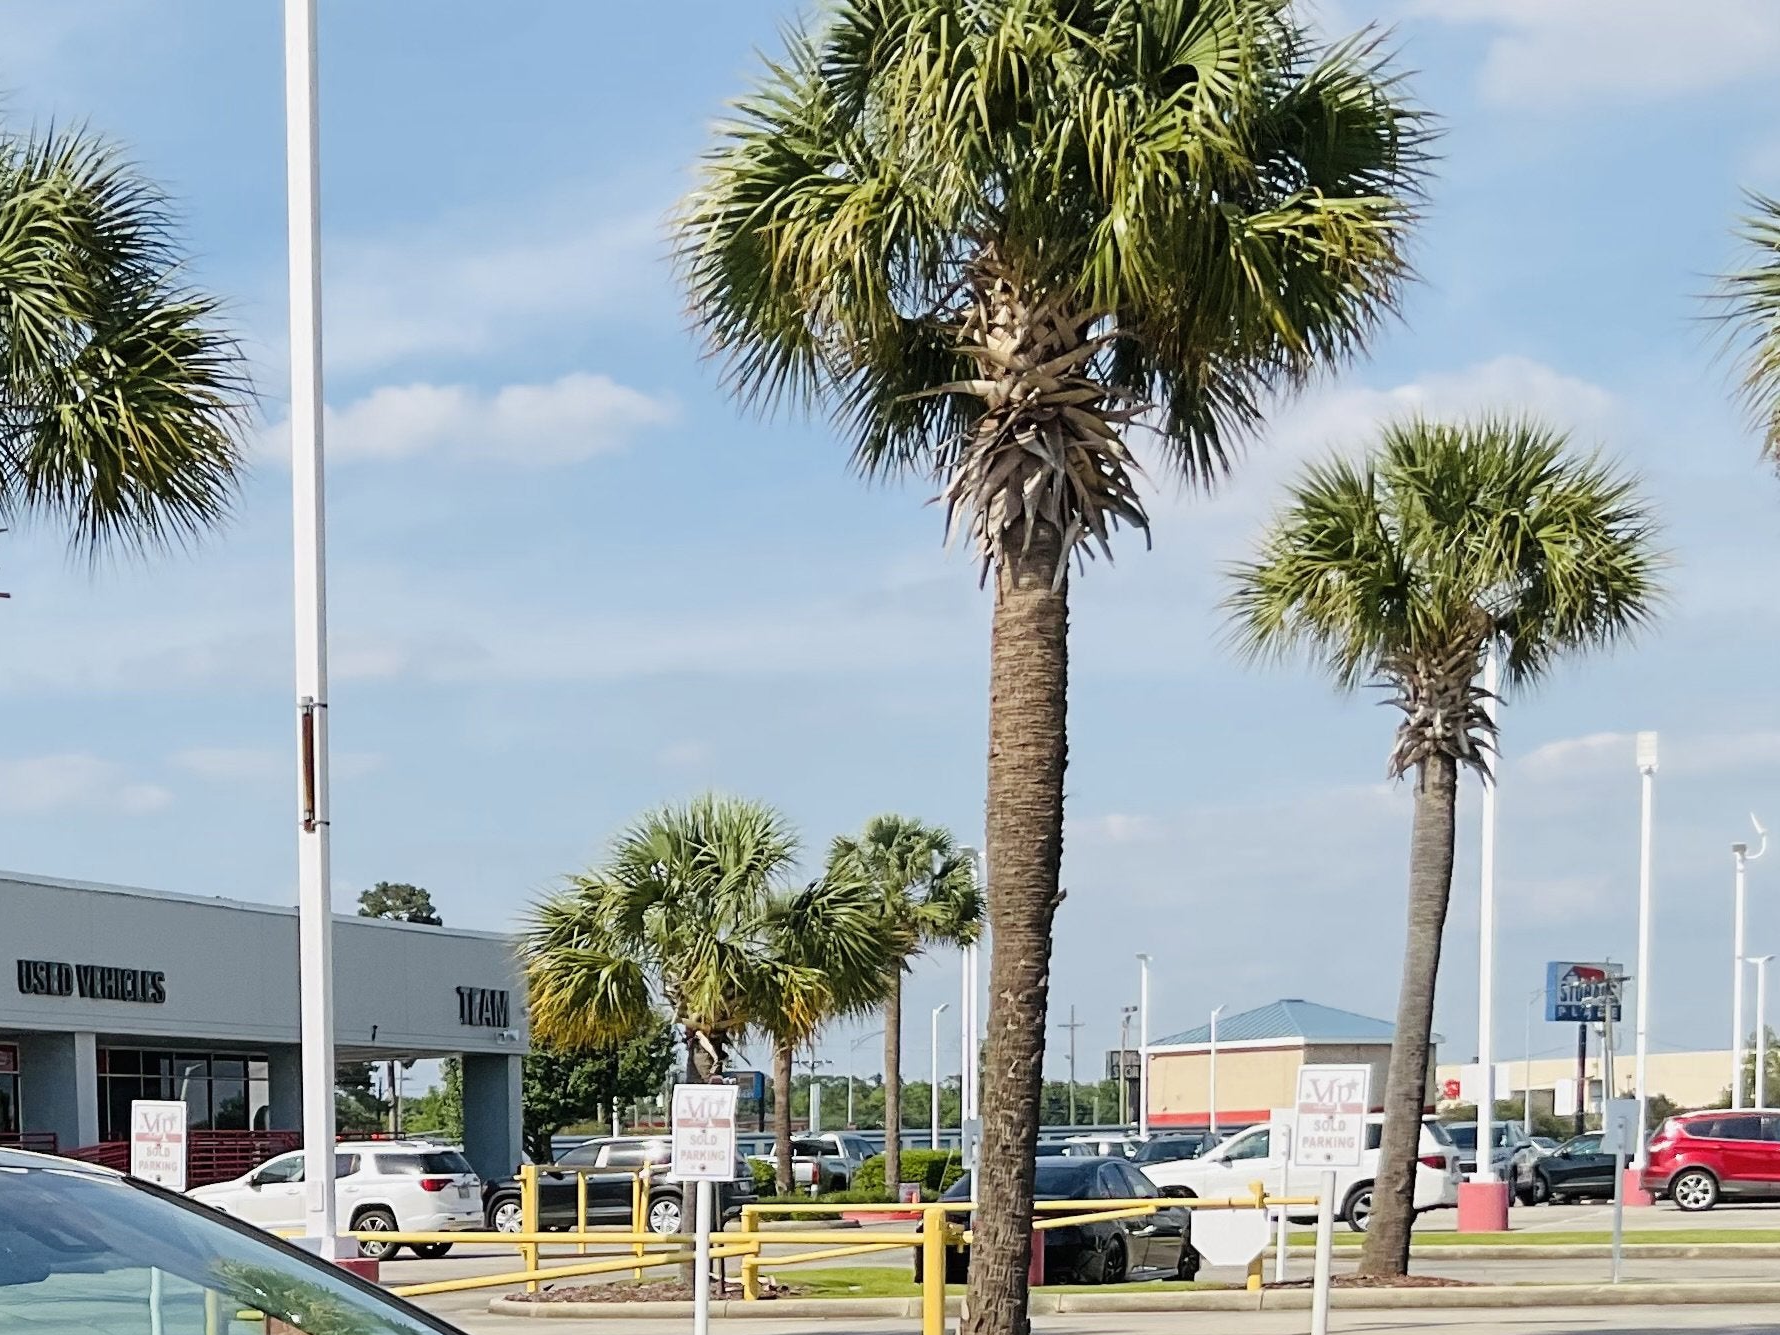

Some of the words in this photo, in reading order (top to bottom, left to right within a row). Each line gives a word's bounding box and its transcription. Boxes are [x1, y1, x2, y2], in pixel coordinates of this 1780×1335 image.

[17, 960, 73, 996] USED
[75, 965, 166, 1003] VEHICLES
[456, 986, 510, 1028] TEAM
[1314, 1119, 1346, 1132] SOLD
[690, 1134, 717, 1146] SOLD
[1301, 1136, 1356, 1149] PARKING
[146, 1146, 170, 1158] SOLD
[680, 1149, 725, 1161] PARKING
[138, 1160, 178, 1172] PARKING
